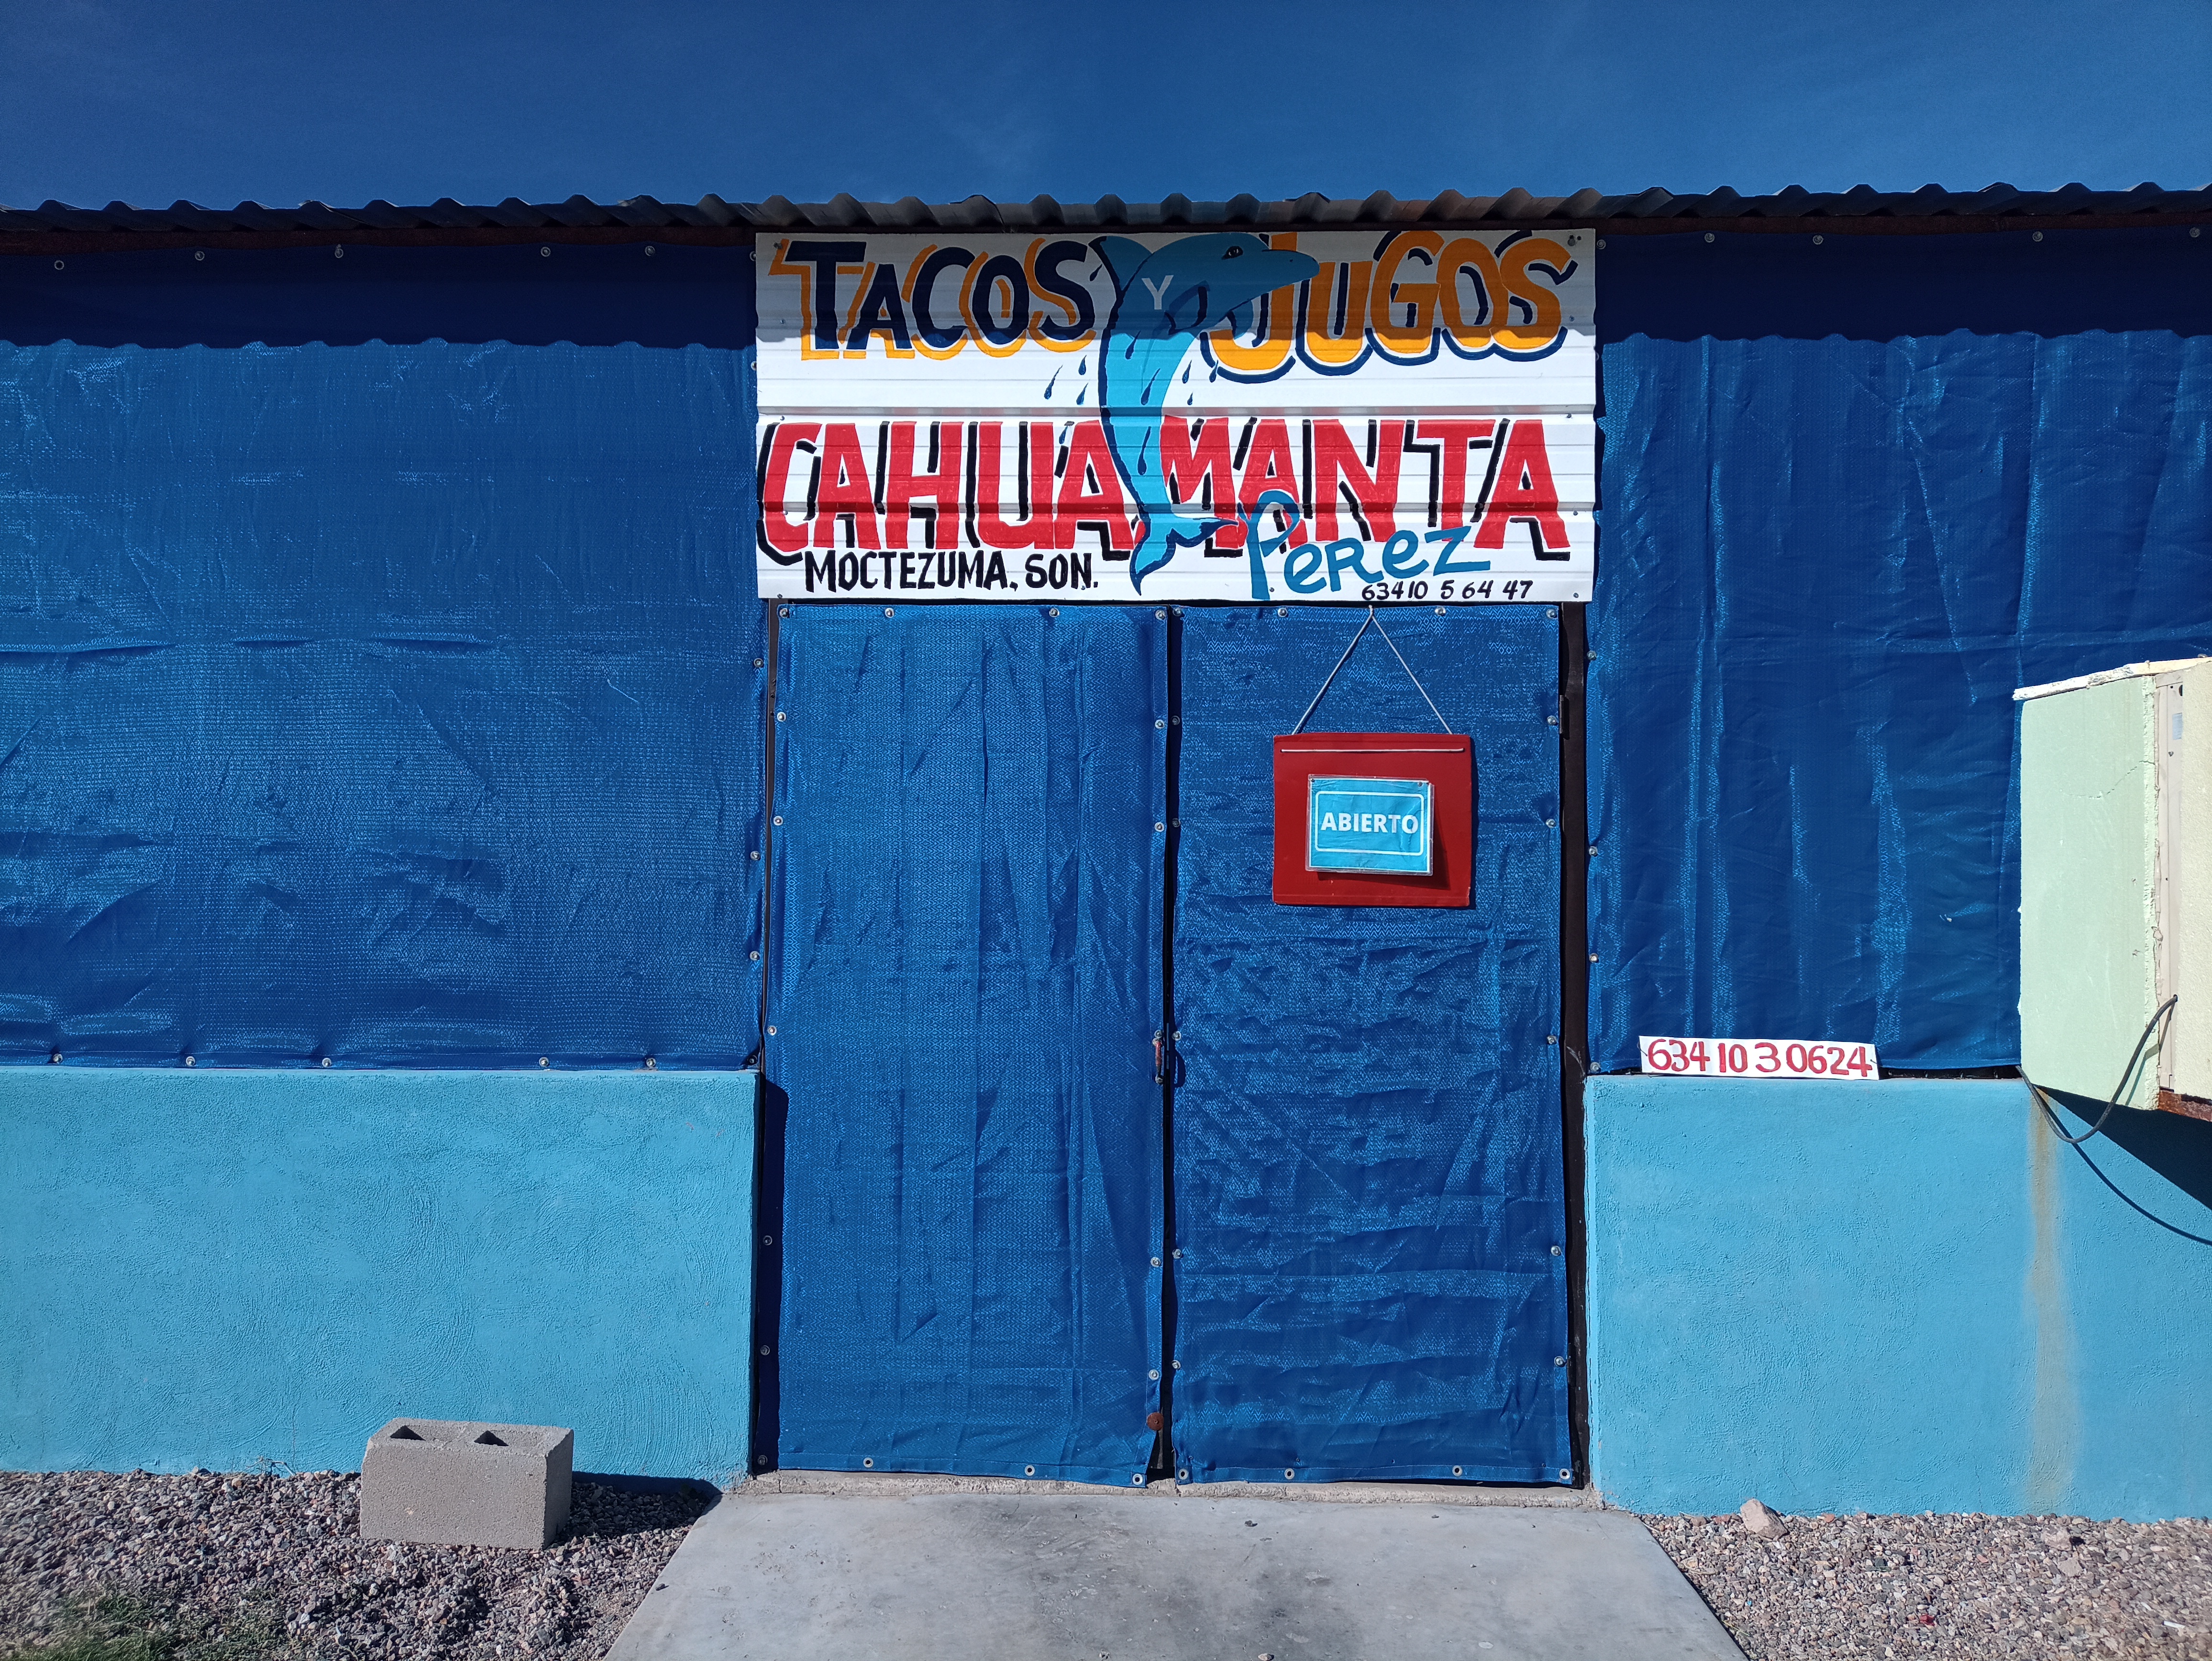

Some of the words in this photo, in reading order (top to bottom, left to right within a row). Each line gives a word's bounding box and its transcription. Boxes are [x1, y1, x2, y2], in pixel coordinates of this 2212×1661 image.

[784, 239, 1095, 351] TACOS
[1141, 274, 1174, 311] Y
[1207, 230, 1572, 372] JUGOS
[763, 415, 1571, 552] CAHUAMANTA
[1025, 552, 1098, 590] SON.
[1320, 812, 1419, 834] ABIERTO
[1648, 1038, 1711, 1072] 634
